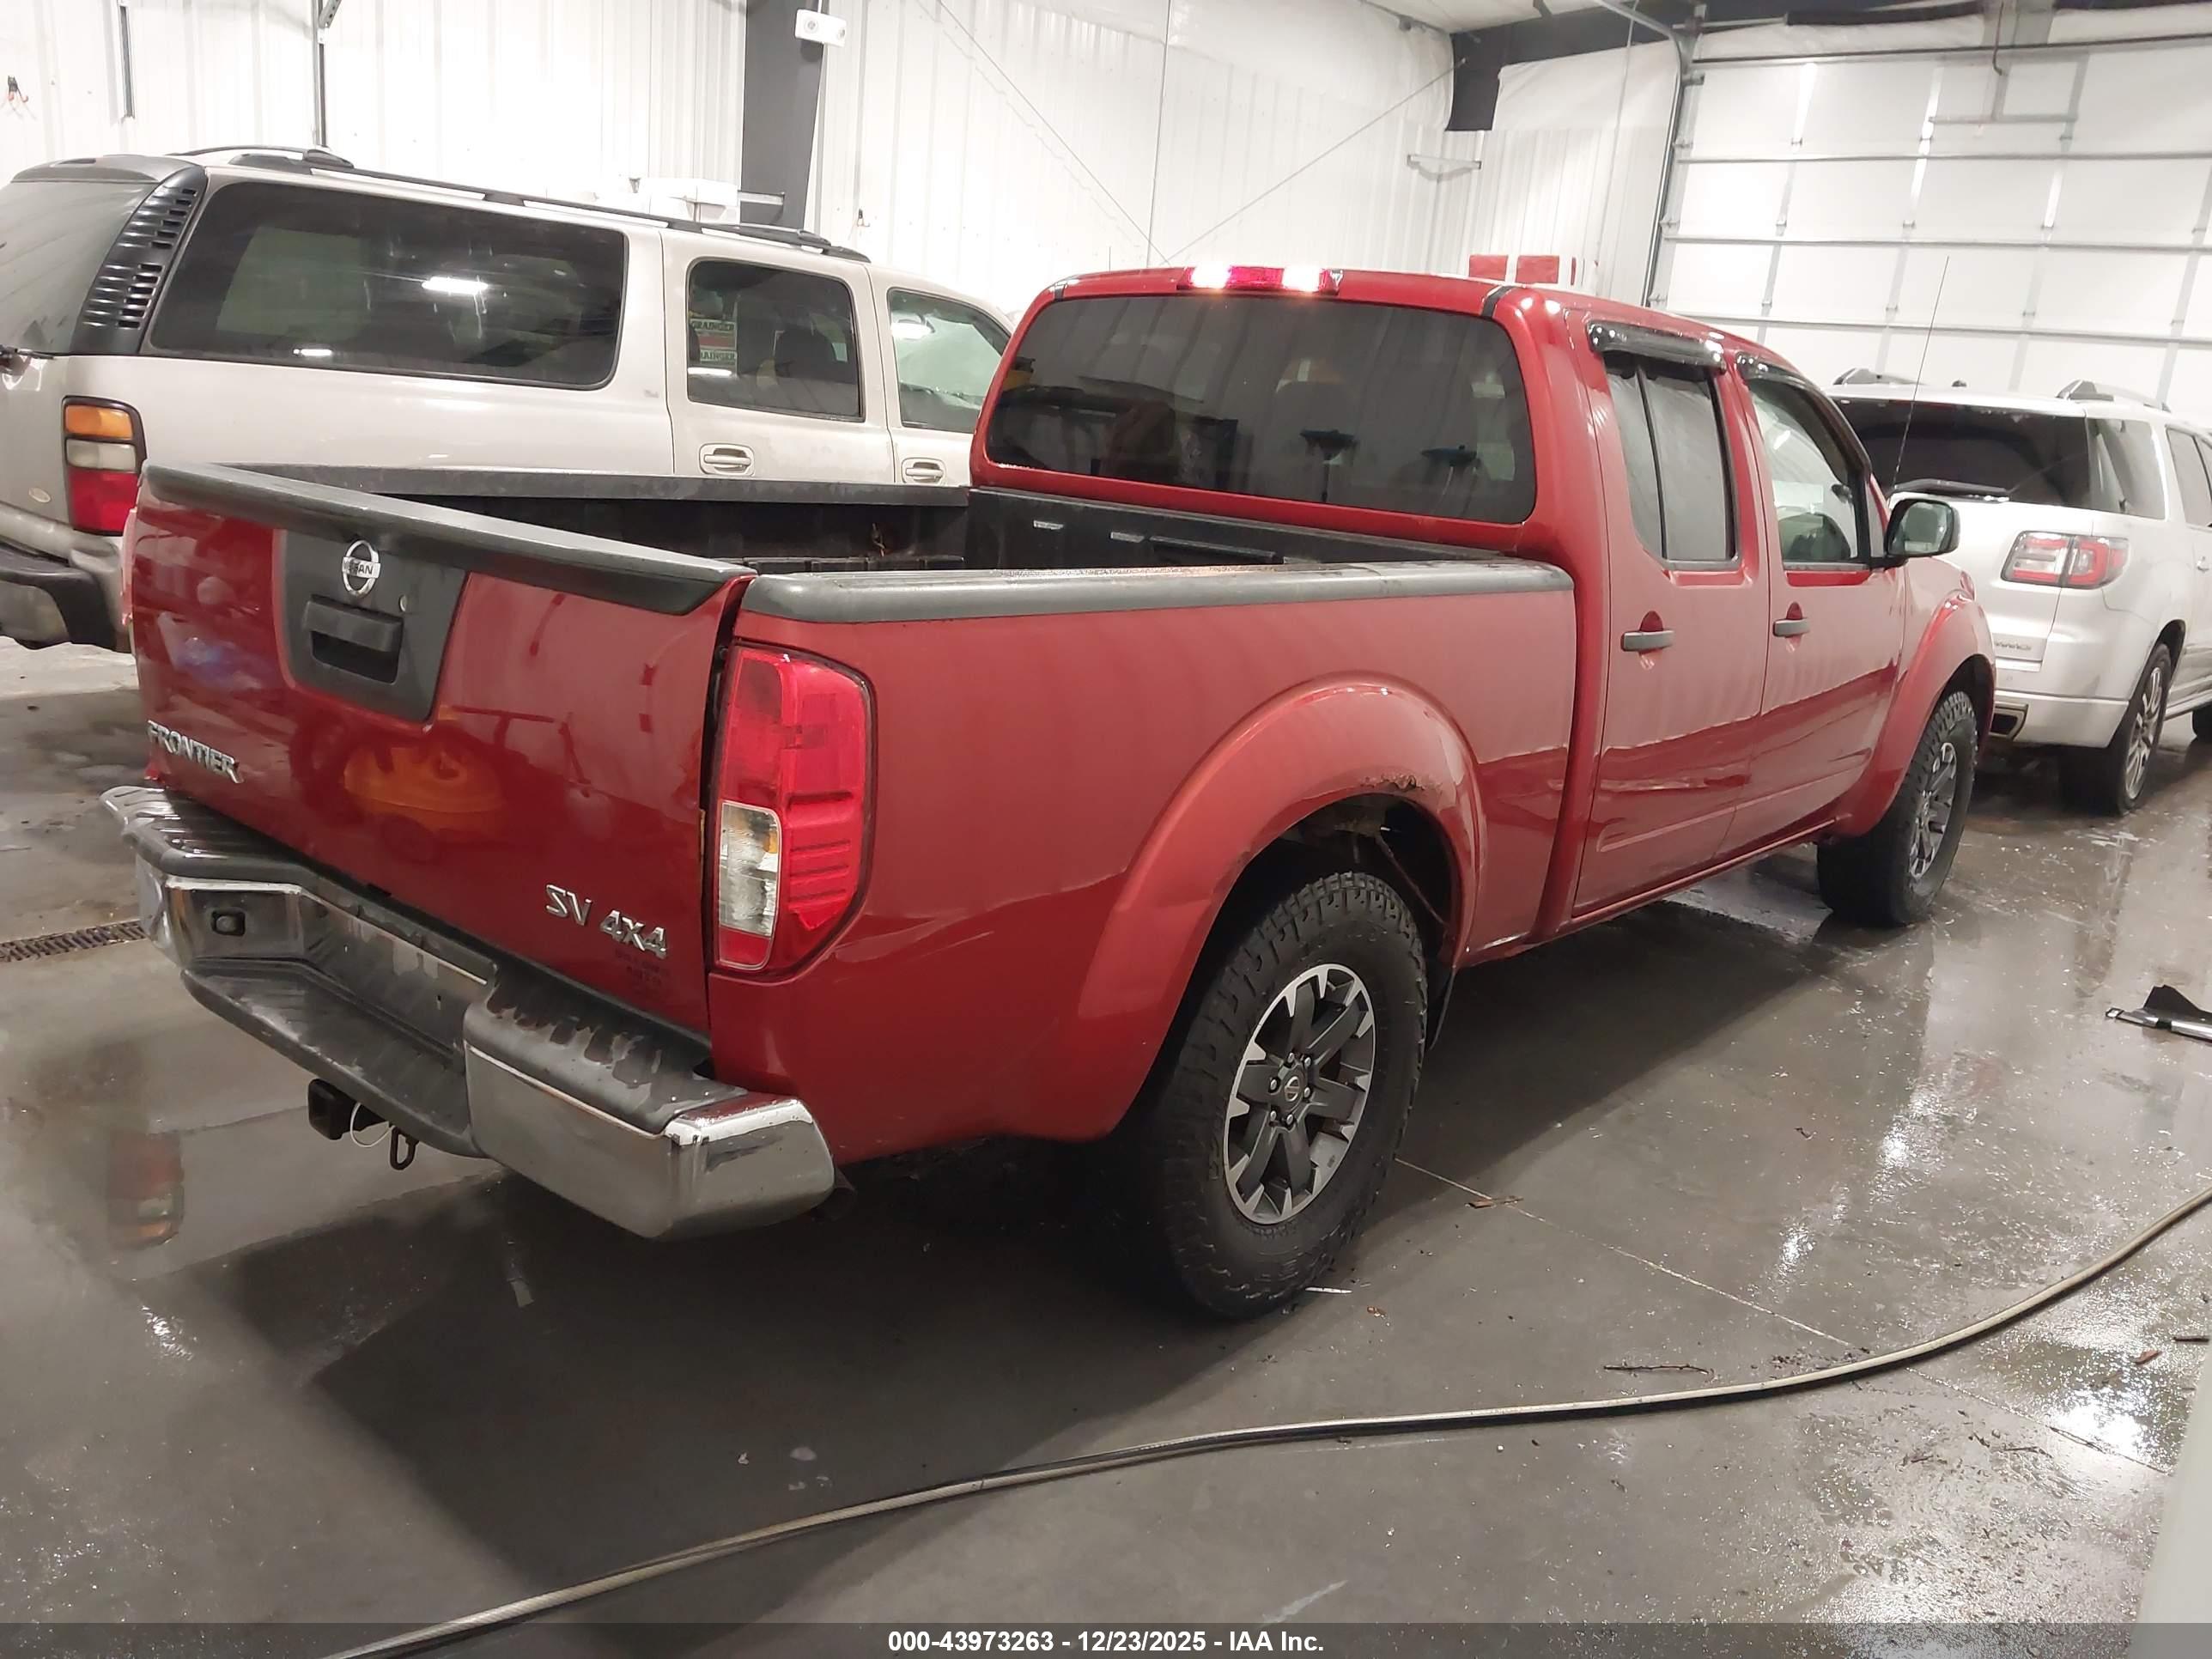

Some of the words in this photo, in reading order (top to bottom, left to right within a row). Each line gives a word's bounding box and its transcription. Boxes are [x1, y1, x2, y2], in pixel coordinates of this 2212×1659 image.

[700, 351, 736, 361] AINGER
[147, 720, 240, 783] FRONTIER
[545, 884, 592, 926] SV
[600, 909, 667, 959] 4X4
